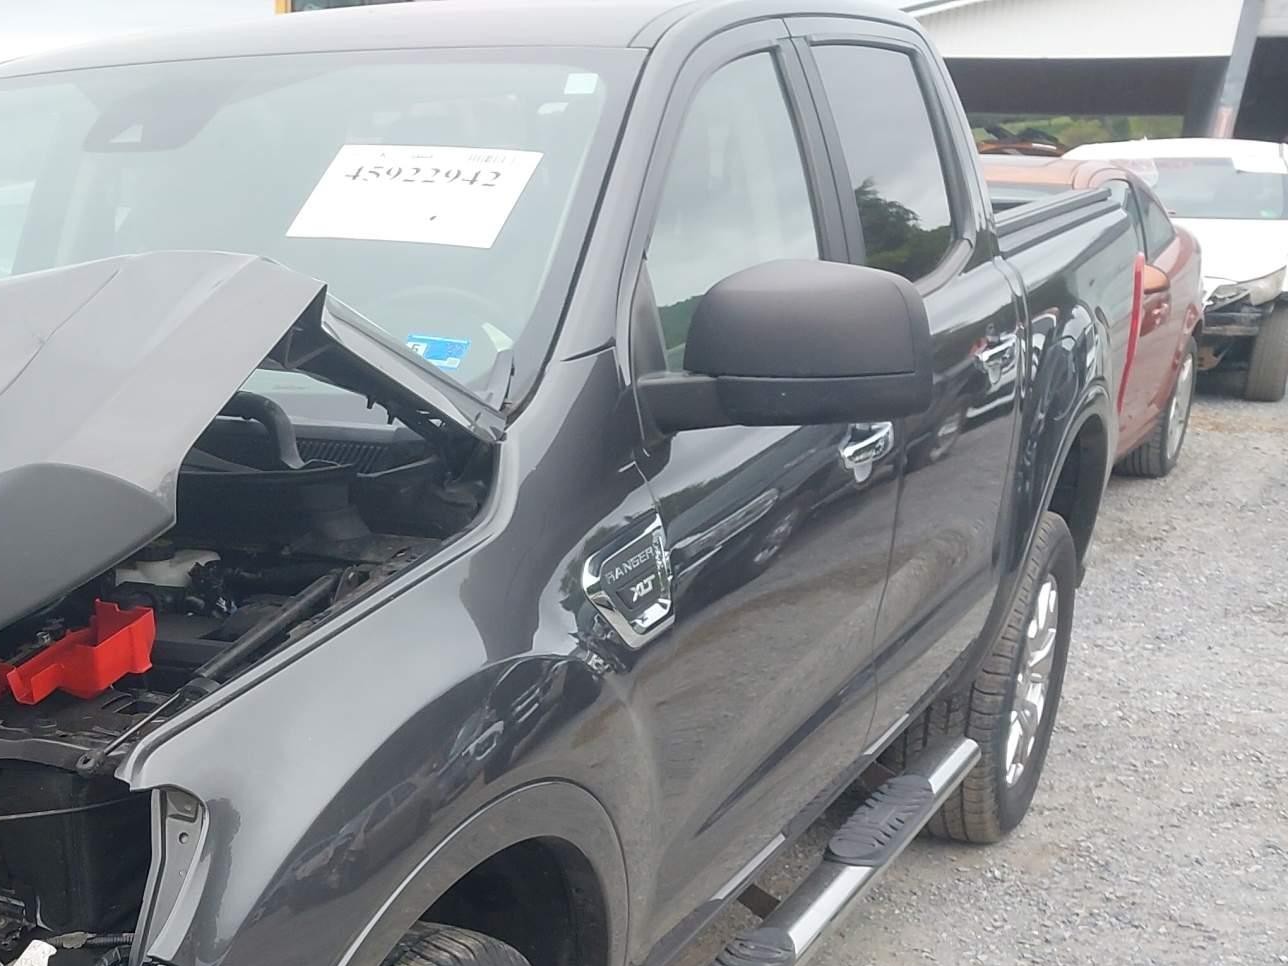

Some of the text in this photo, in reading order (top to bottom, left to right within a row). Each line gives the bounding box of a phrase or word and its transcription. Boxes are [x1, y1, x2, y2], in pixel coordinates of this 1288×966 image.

[344, 165, 502, 188] 45922942
[605, 545, 655, 584] RANGER
[630, 574, 655, 602] XLT
